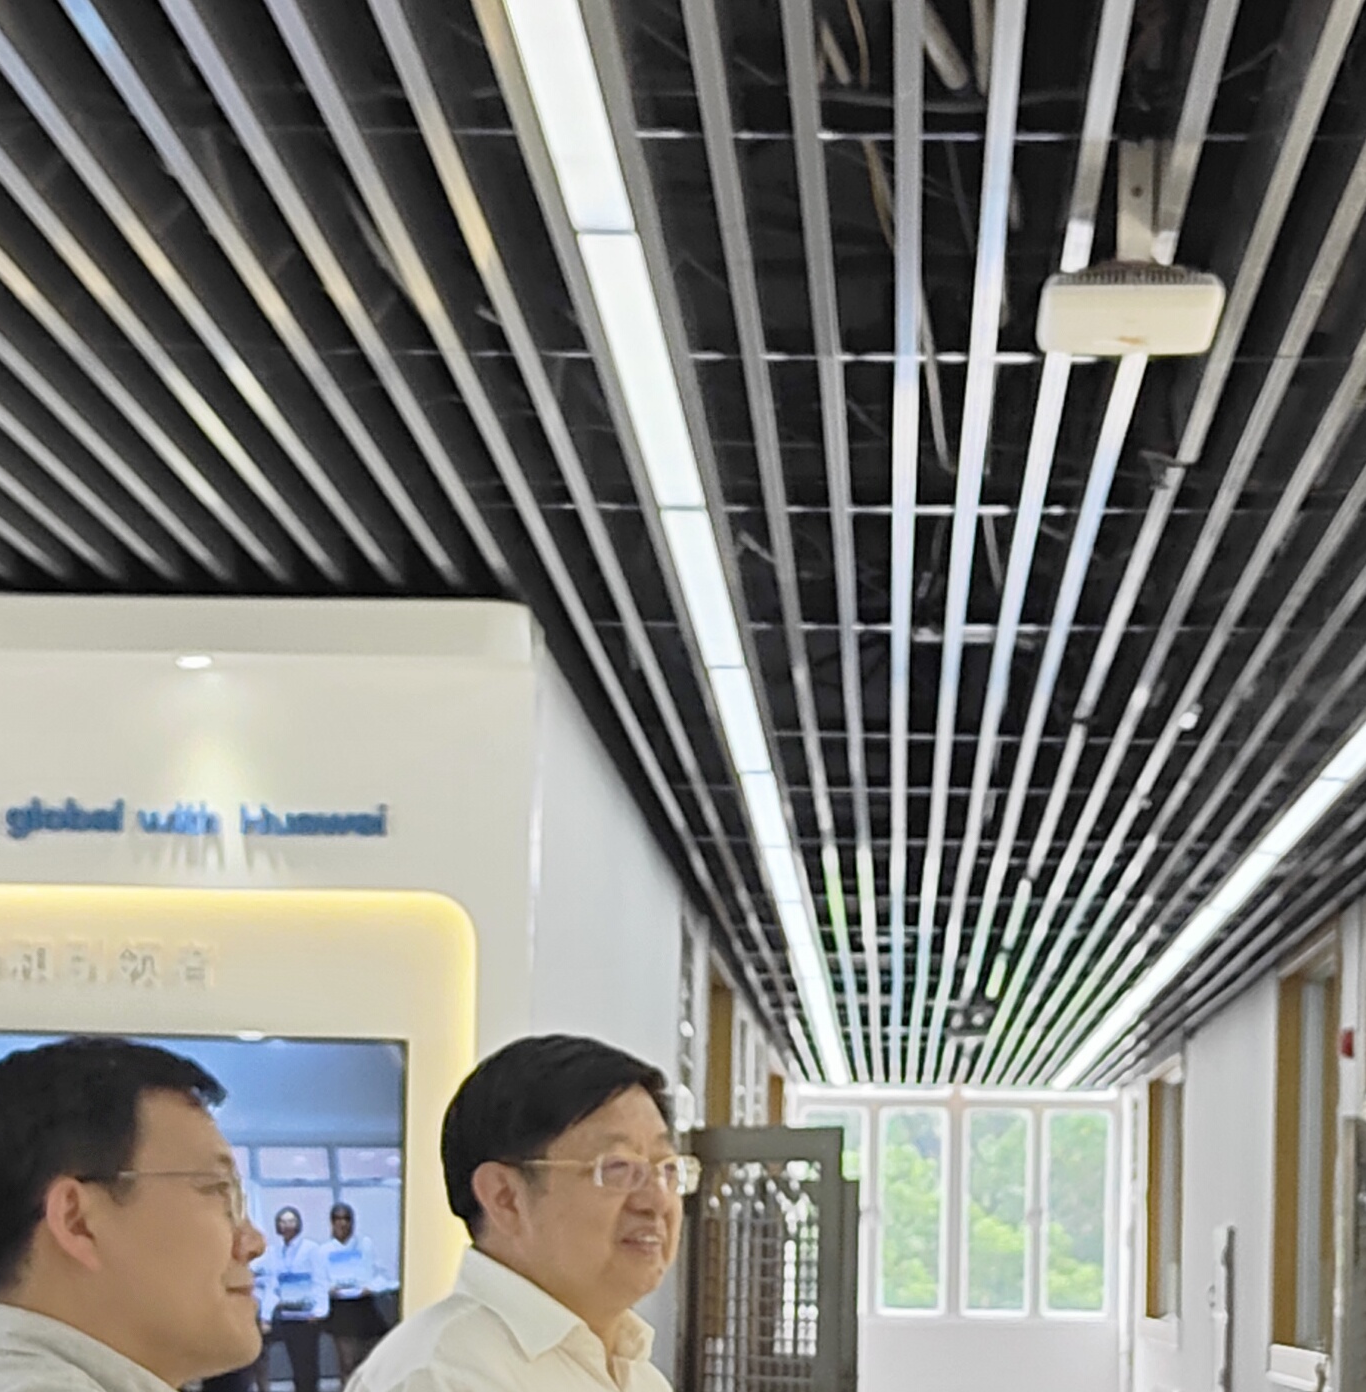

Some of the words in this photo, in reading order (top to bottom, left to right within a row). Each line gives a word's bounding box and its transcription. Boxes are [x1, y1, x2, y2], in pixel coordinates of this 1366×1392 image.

[6, 796, 125, 840] global
[137, 801, 221, 836] with
[240, 803, 388, 838] Huawei
